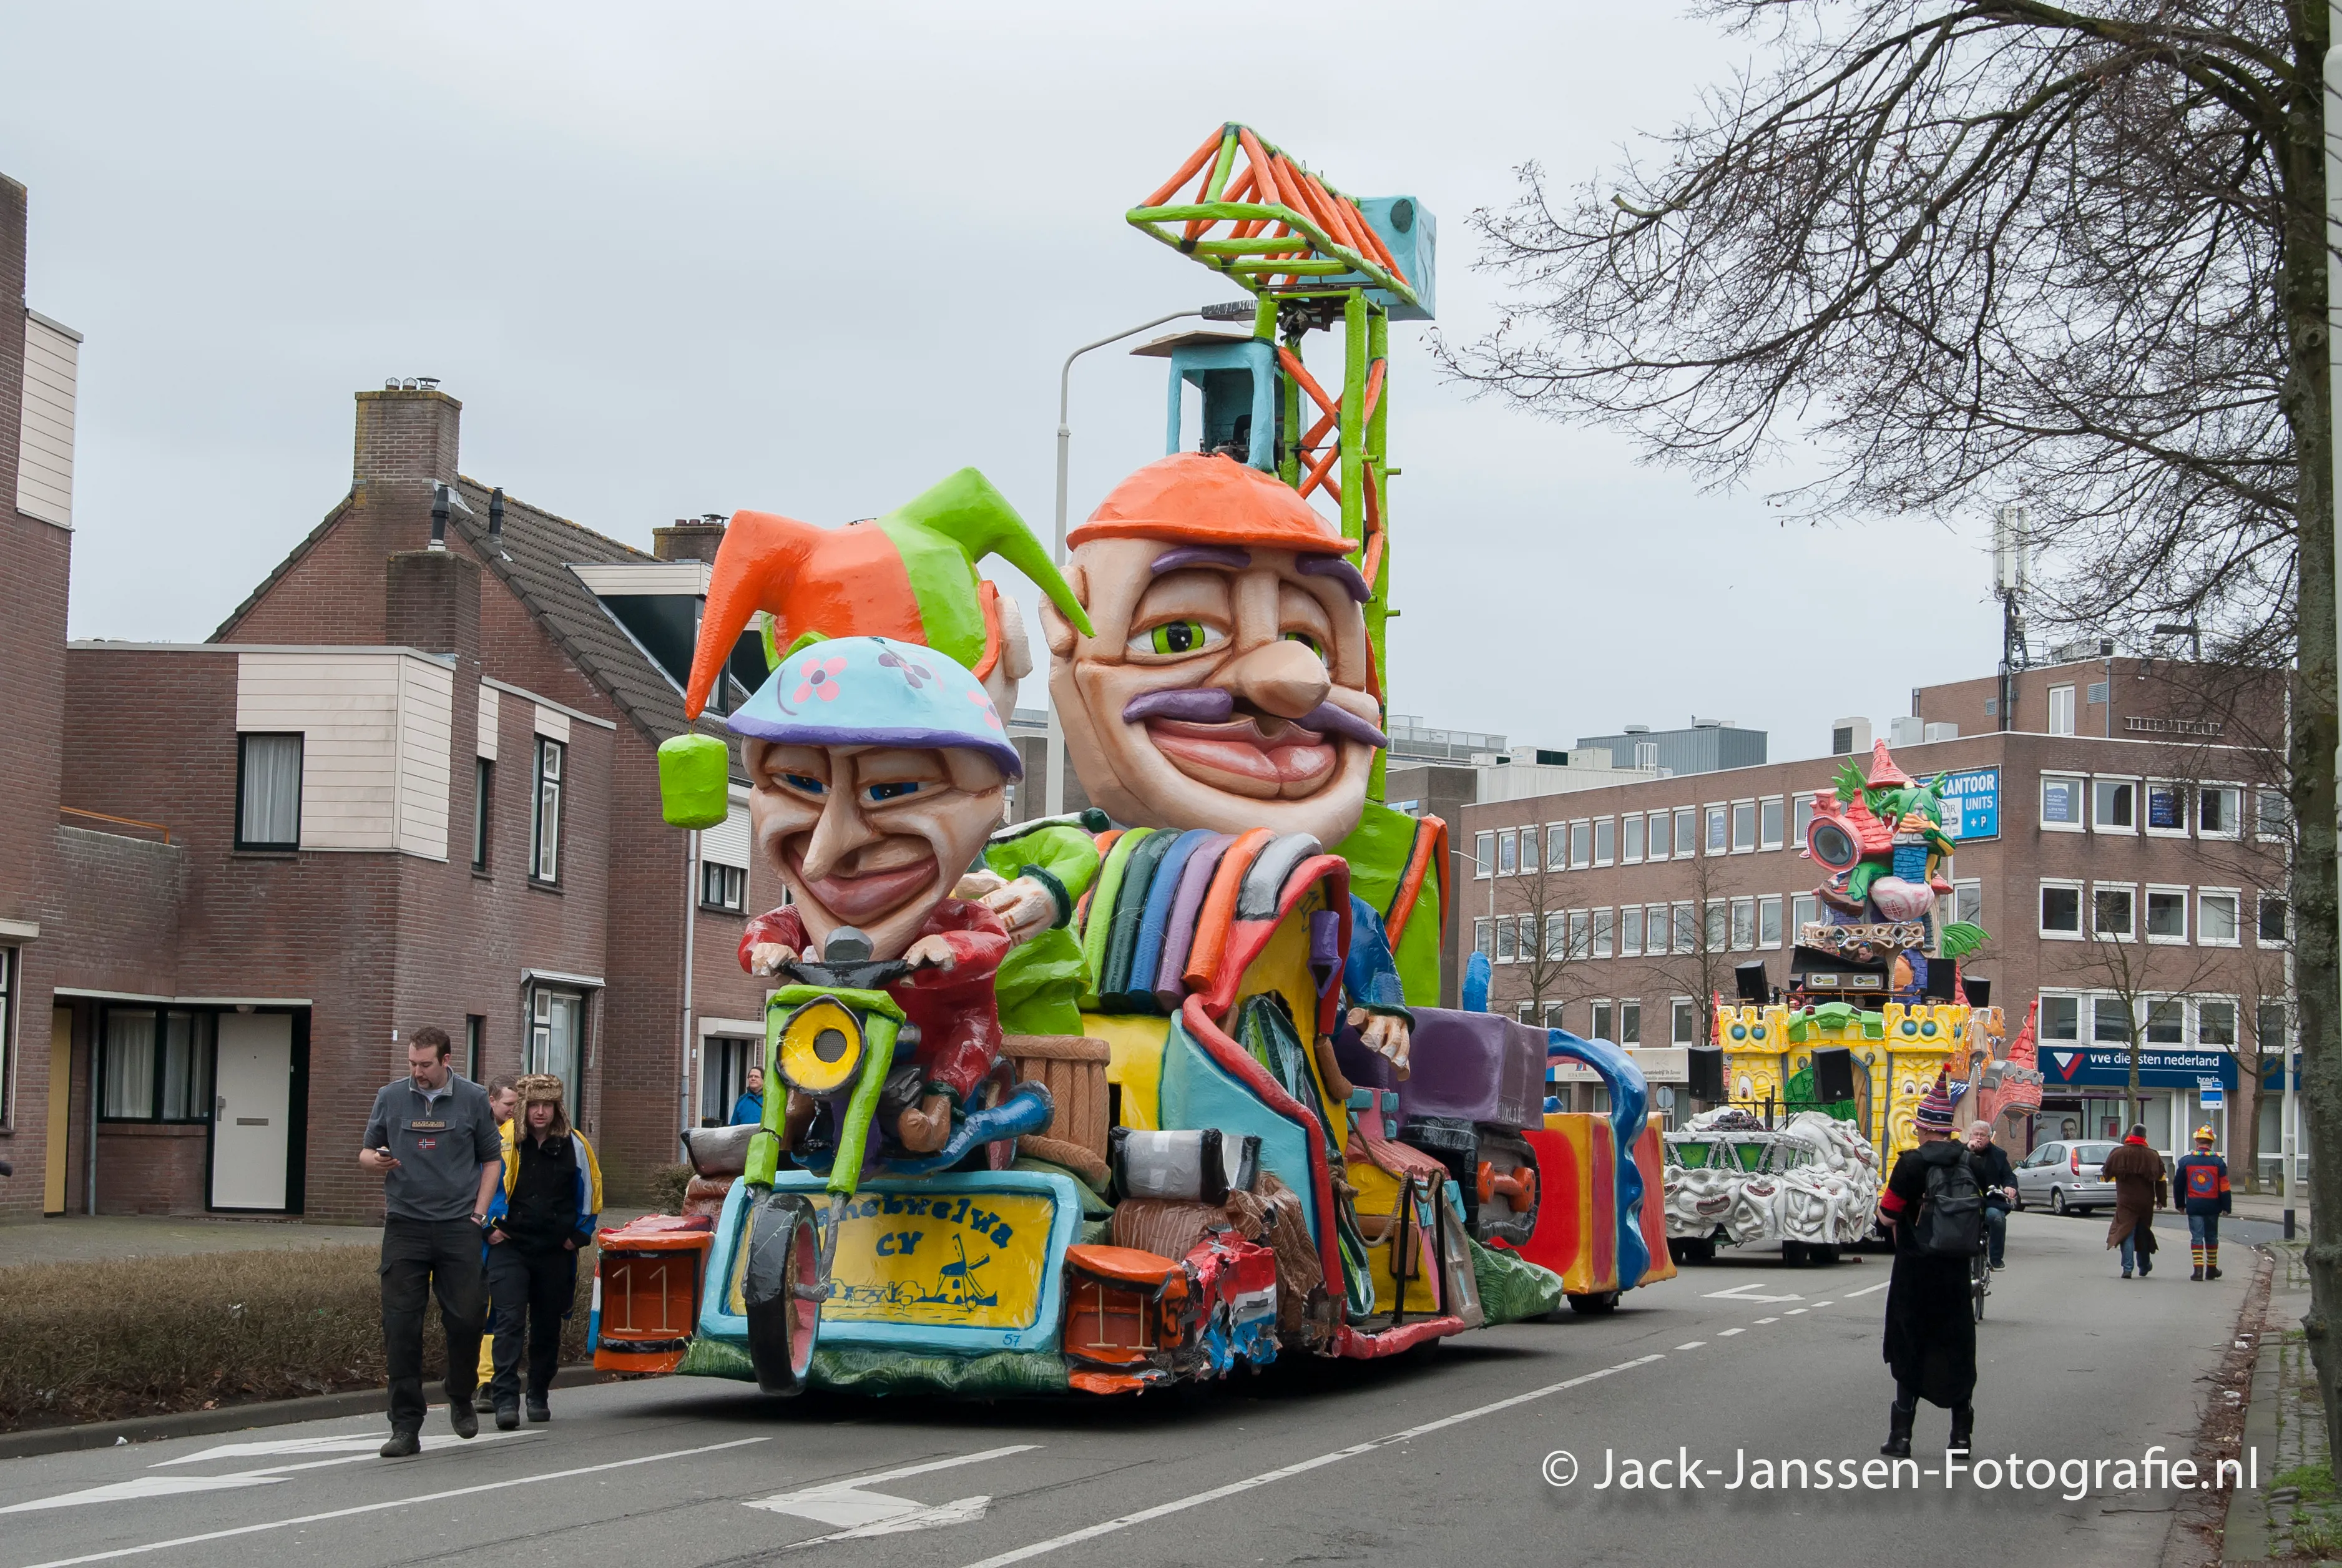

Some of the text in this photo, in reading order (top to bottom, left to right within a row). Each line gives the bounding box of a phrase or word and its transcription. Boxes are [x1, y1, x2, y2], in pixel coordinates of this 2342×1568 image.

[1966, 795, 1993, 810] UNITS
[1981, 816, 1987, 828] P
[2090, 1052, 2220, 1067] vve diesten nederland
[2197, 1075, 2219, 1083] breda
[1002, 1333, 1021, 1347] 57
